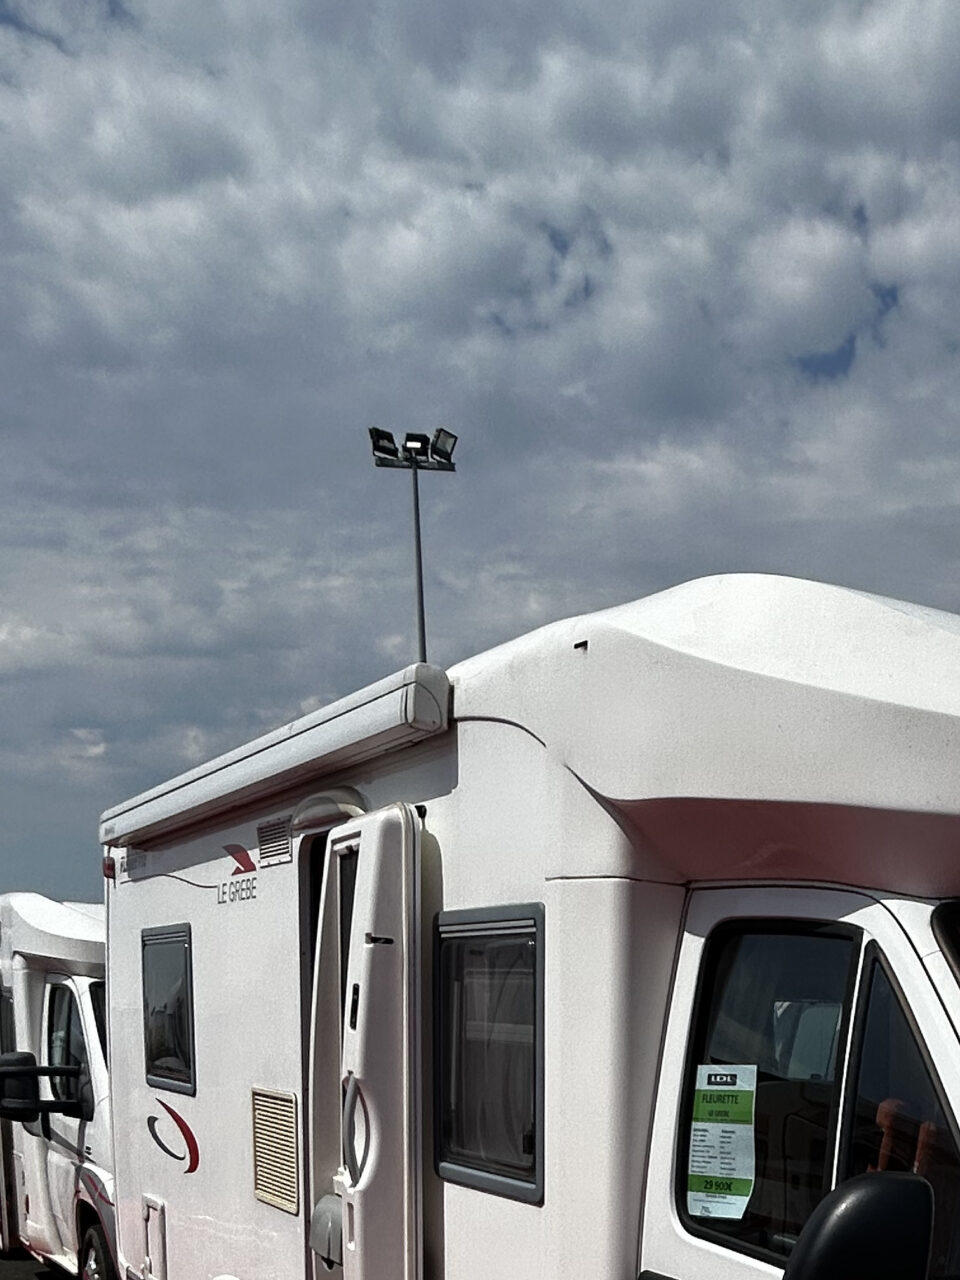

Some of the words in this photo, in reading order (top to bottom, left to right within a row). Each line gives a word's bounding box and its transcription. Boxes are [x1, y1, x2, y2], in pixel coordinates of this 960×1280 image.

[218, 882, 228, 904] LE
[229, 877, 257, 902] GREBE
[701, 1093, 740, 1105] FLEURETTE
